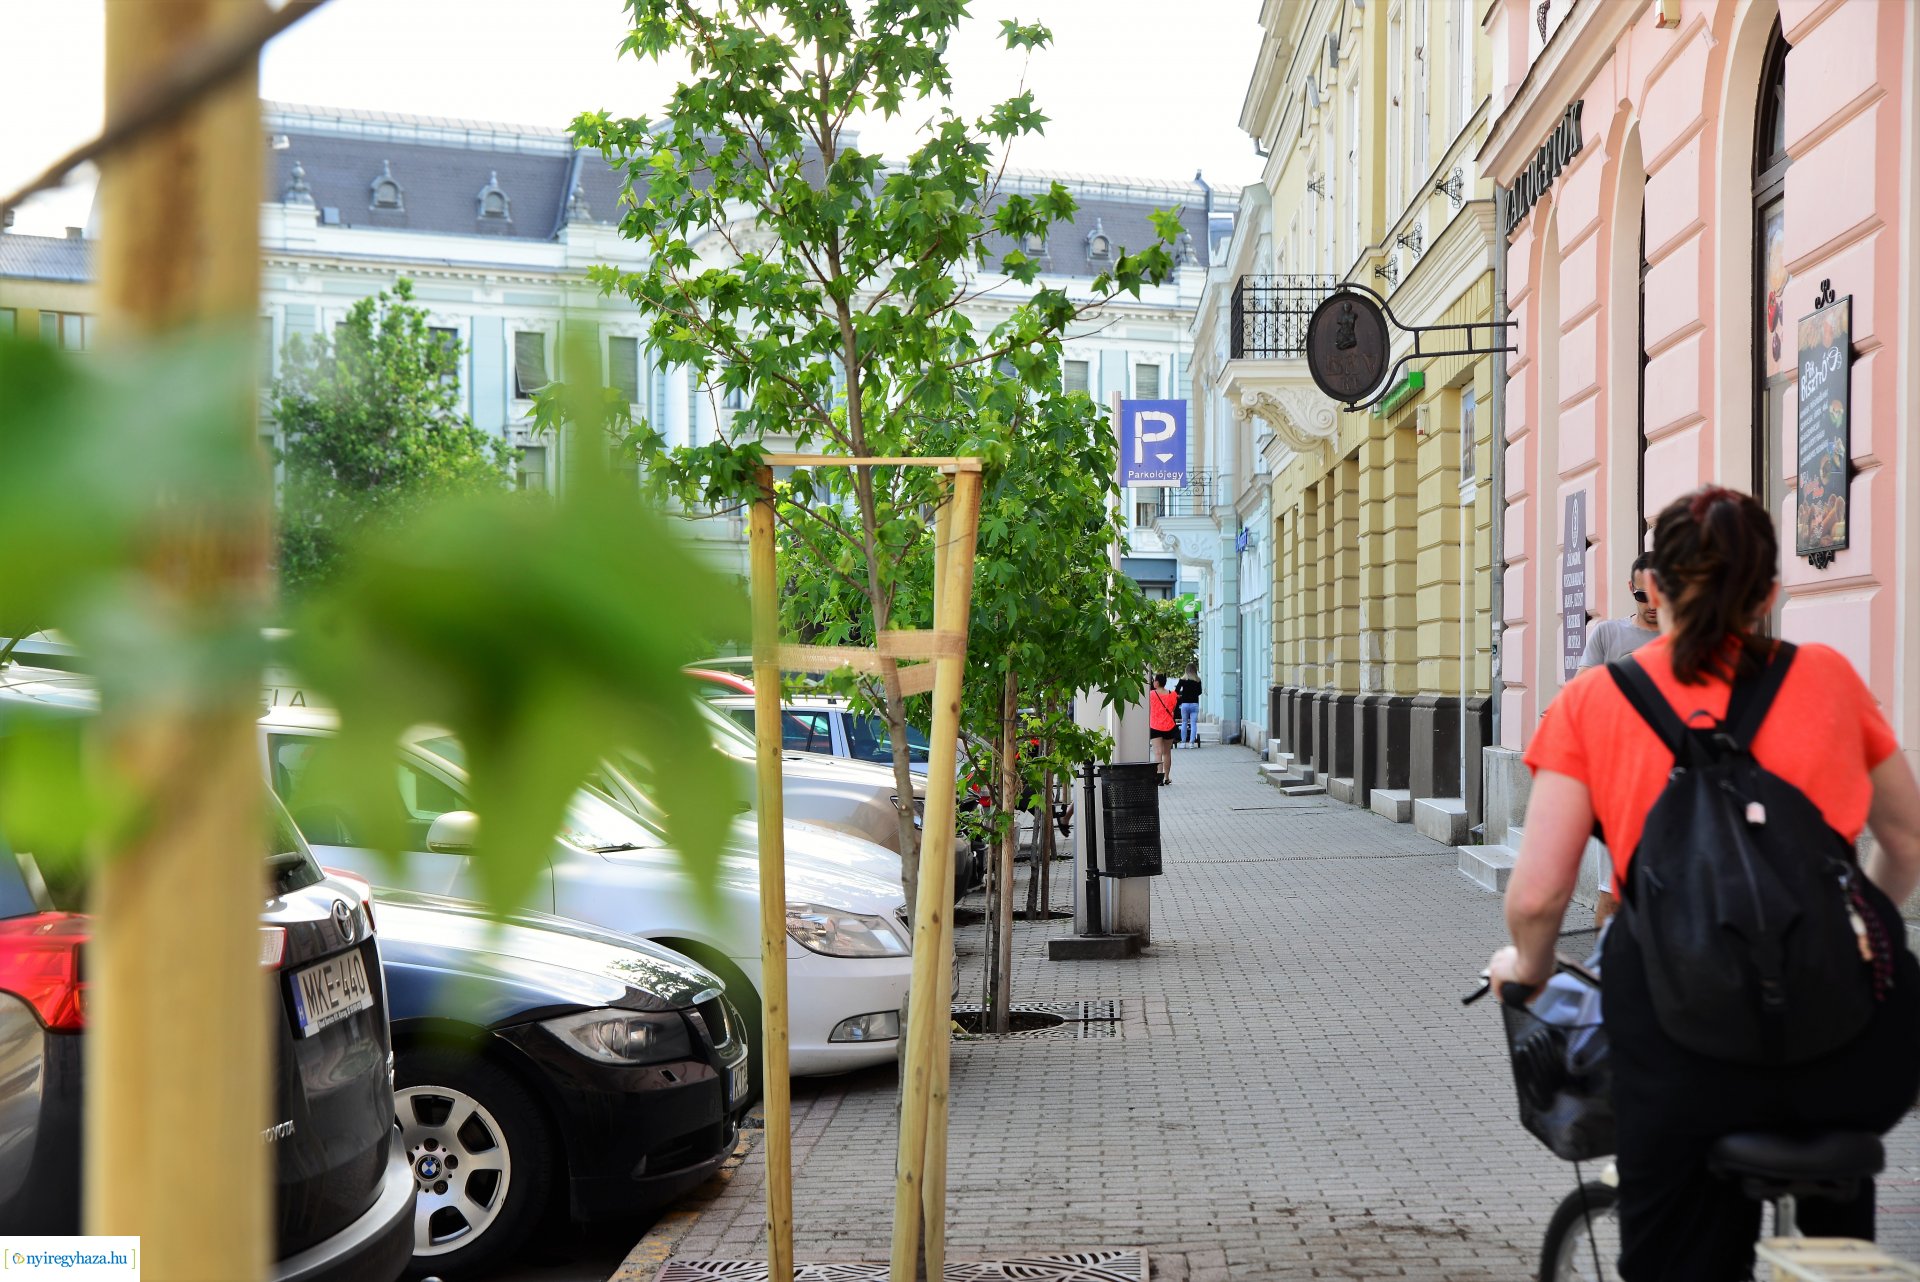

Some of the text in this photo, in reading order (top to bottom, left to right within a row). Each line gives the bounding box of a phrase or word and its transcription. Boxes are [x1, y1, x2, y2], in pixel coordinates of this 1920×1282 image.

[1134, 410, 1176, 464] P
[1128, 470, 1184, 480] Parkolójegy
[302, 954, 366, 1019] MKE-440
